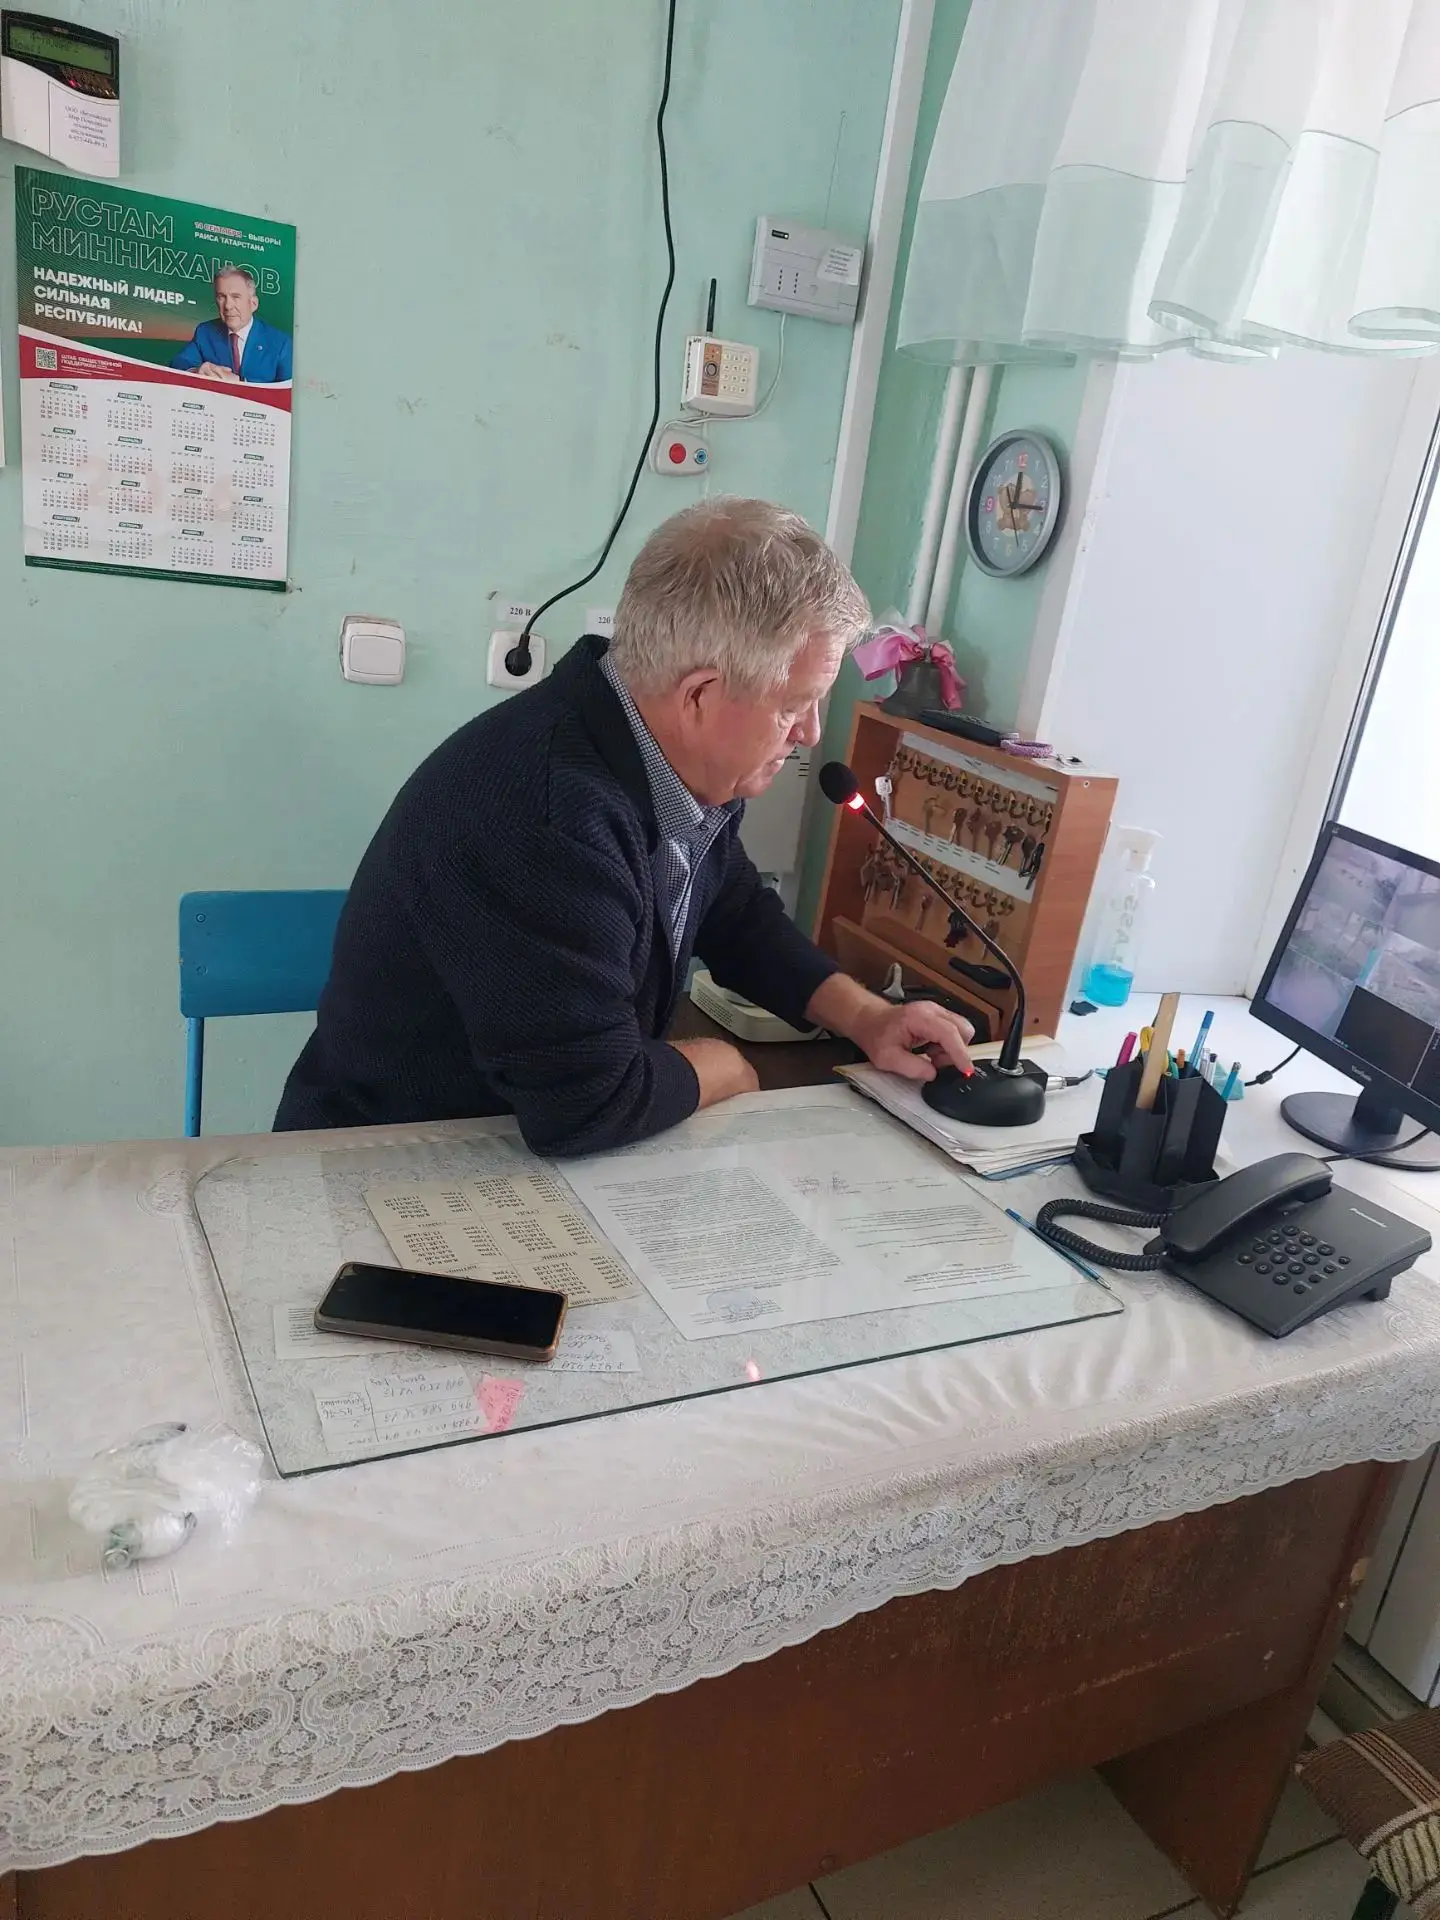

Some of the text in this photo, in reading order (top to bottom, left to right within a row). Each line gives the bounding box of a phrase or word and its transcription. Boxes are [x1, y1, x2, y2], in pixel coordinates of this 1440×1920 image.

[32, 187, 174, 243] РУСТАМ
[194, 232, 264, 252] РАИСА ТАТАРСТАНА
[248, 234, 281, 246] ВЫБОРЫ
[33, 266, 129, 296] НАДЕЖНЫЙ
[132, 286, 184, 305] ЛИДЕР
[33, 285, 111, 310] СИЛЬНАЯ
[34, 303, 143, 334] РЕСПУБЛИКА!
[510, 607, 524, 616] 220
